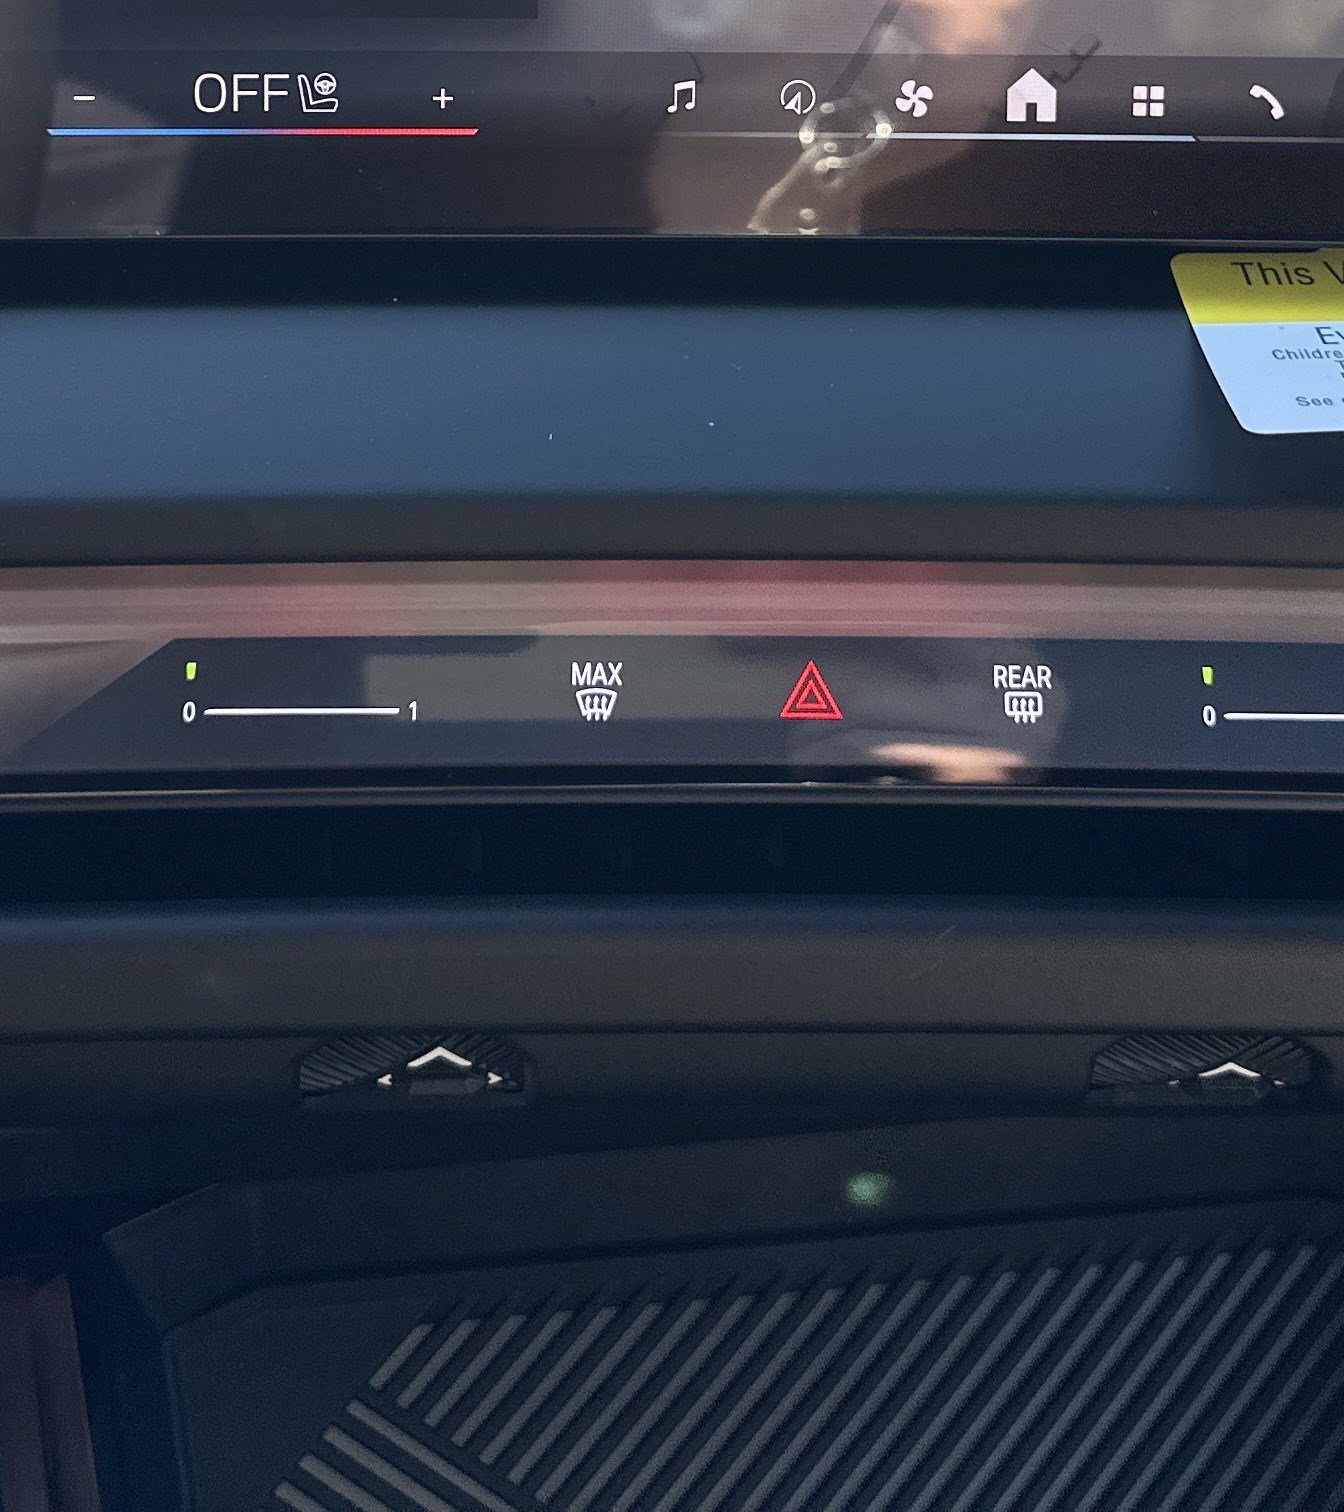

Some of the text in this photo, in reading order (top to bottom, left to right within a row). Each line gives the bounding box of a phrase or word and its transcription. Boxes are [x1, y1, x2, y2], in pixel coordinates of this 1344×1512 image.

[192, 72, 291, 113] OFF
[1230, 260, 1316, 287] This
[1295, 395, 1334, 408] See
[570, 661, 623, 687] MAX
[992, 664, 1052, 688] REAR
[182, 700, 196, 723] 0
[407, 700, 418, 722] 1
[1202, 705, 1216, 727] 0
